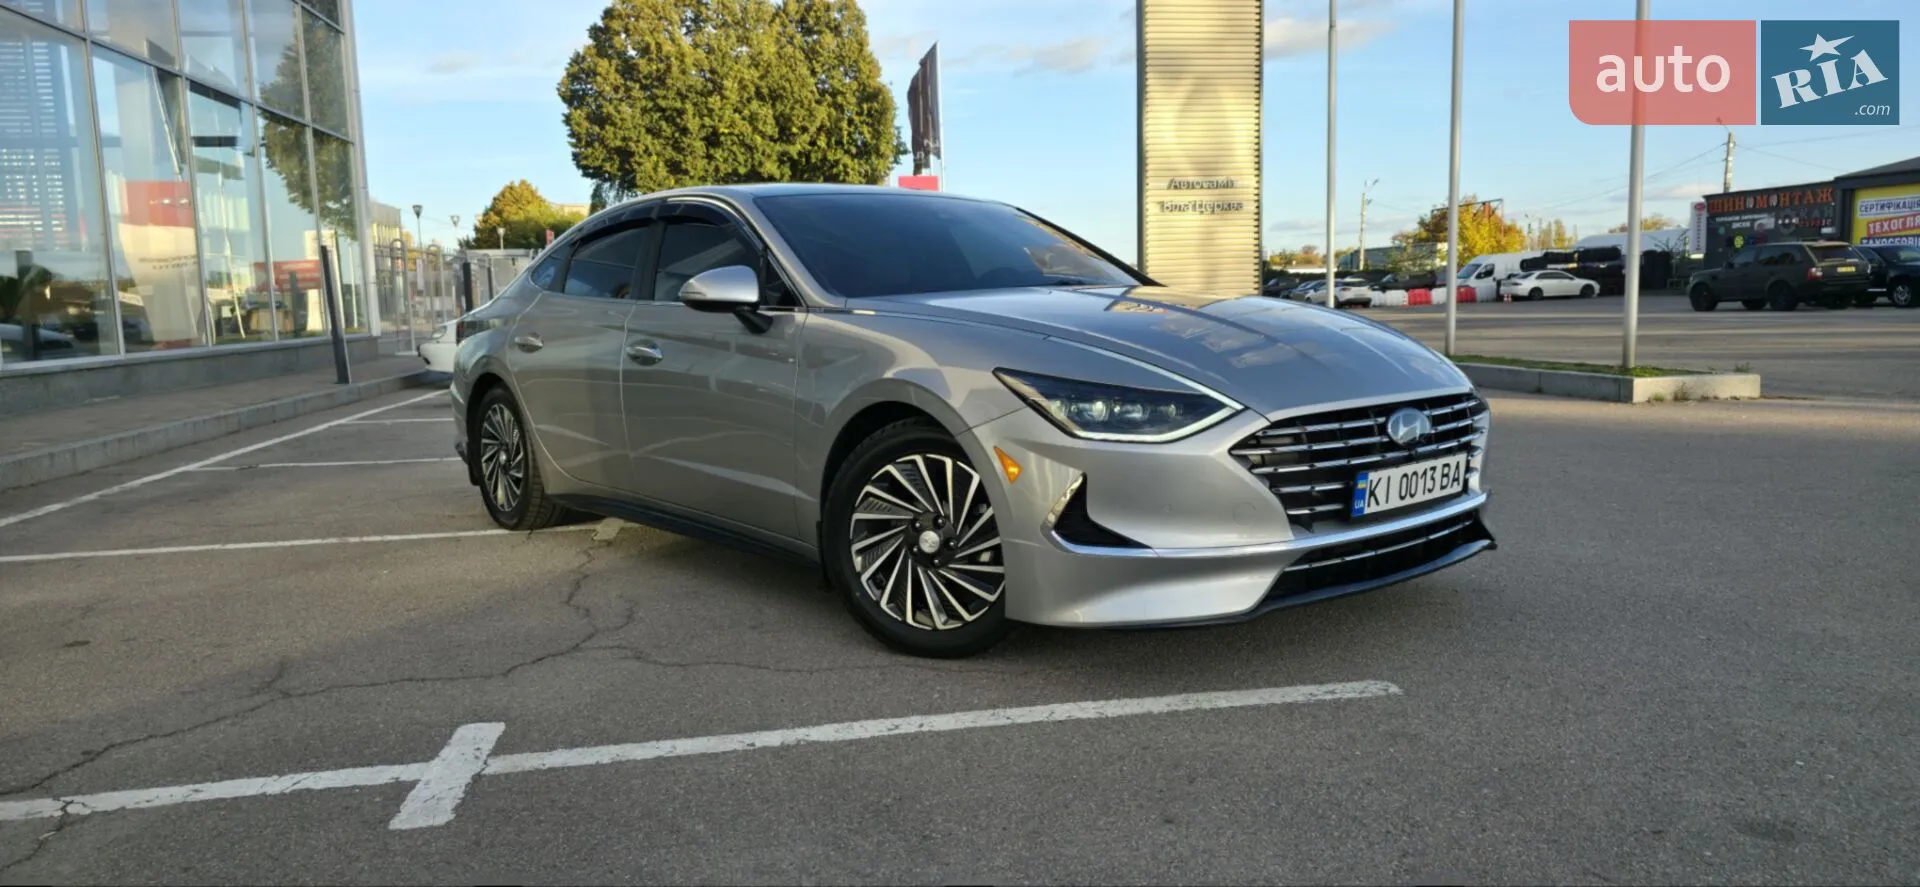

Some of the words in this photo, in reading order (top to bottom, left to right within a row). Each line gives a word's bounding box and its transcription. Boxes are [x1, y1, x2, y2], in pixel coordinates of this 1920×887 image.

[1367, 475, 1391, 508] KI
[1398, 466, 1437, 501] 0013
[1439, 460, 1461, 491] BA
[1354, 499, 1365, 509] UA
